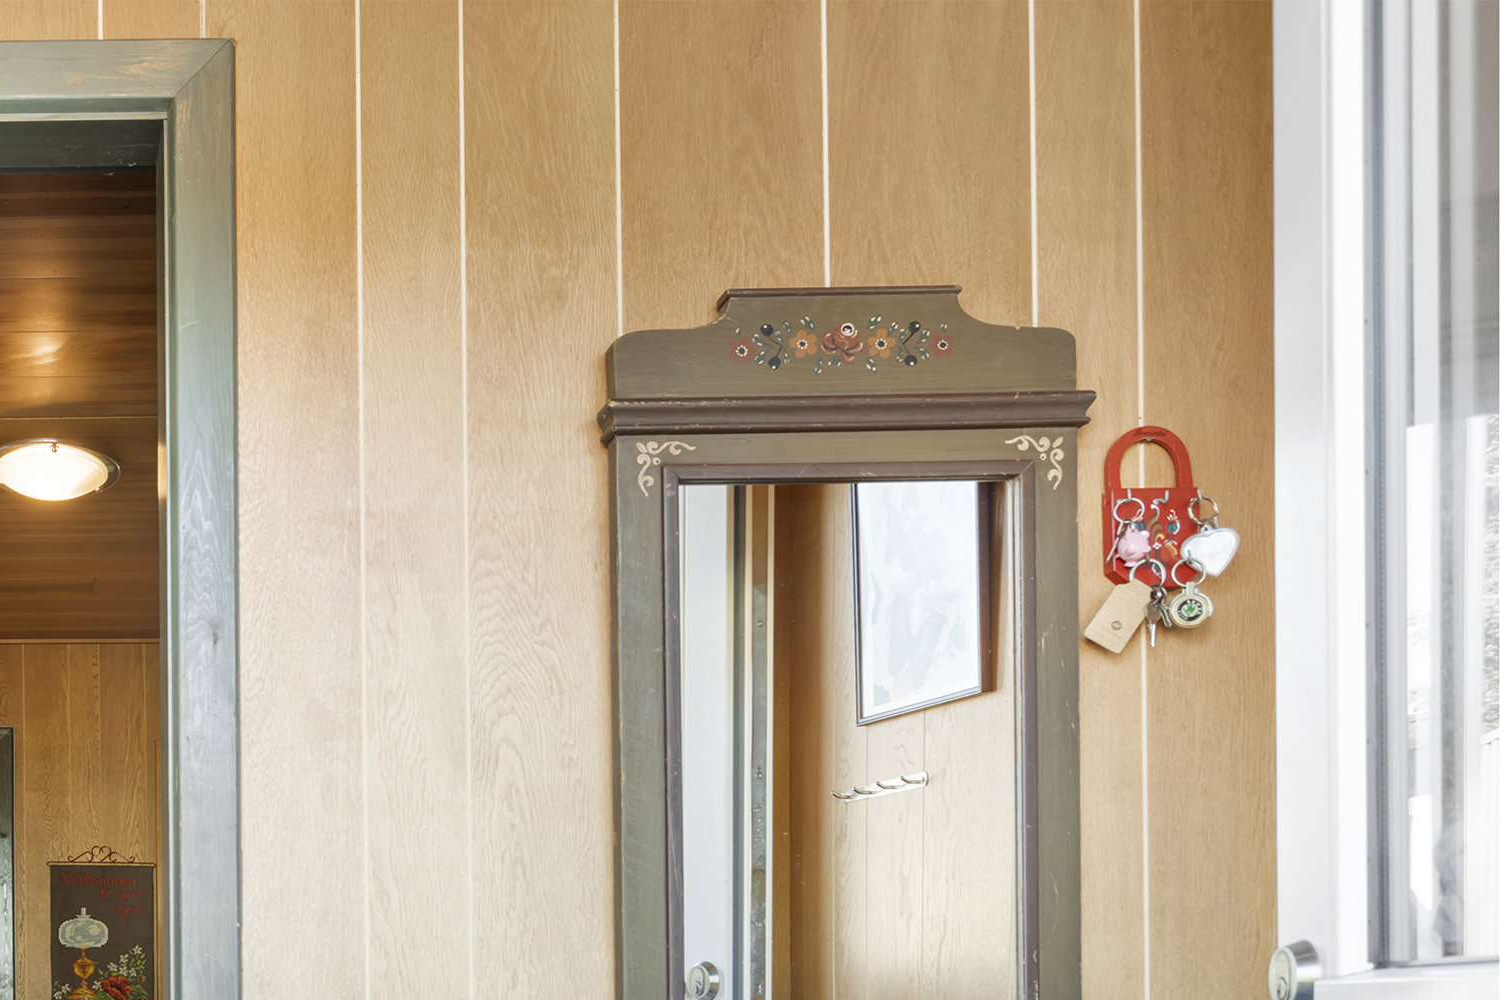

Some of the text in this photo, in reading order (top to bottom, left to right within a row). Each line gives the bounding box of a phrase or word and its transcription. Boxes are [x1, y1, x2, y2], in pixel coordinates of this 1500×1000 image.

[100, 887, 141, 900] til vort
[116, 901, 144, 918] hjem
